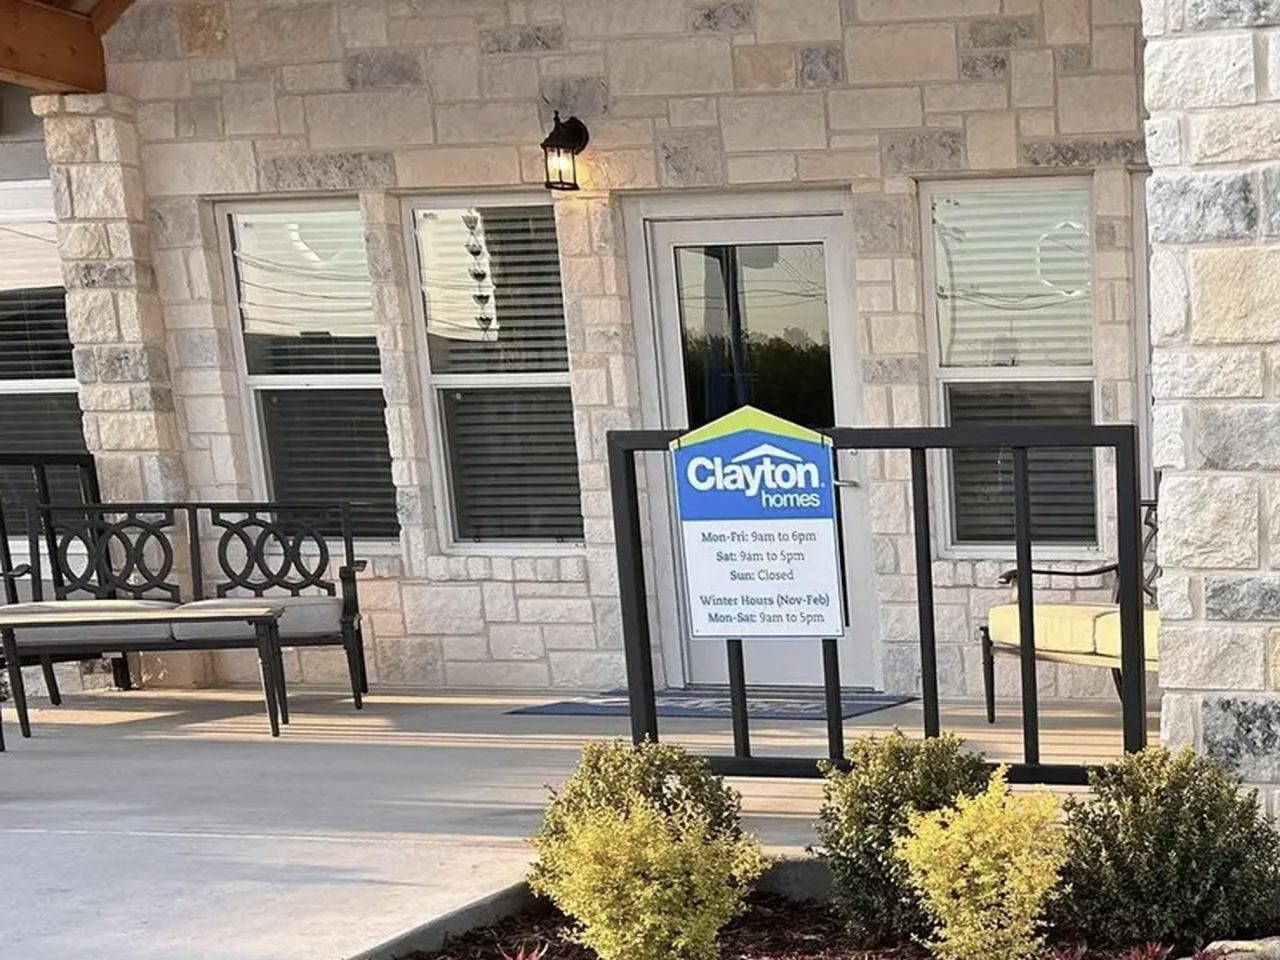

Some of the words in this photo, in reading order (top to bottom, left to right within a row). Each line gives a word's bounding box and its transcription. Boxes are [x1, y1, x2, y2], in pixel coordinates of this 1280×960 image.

[687, 456, 819, 496] Clayton
[761, 491, 821, 508] homes
[701, 531, 749, 543] Mon-Fri:
[752, 531, 775, 542] 9am
[778, 531, 790, 542] to
[792, 530, 817, 544] 6pm
[716, 551, 737, 562] Sat:
[740, 551, 764, 562] 9am
[767, 551, 778, 562] to
[781, 550, 805, 564] 5pm
[730, 570, 755, 581] Sun:
[758, 569, 794, 581] Closed
[700, 595, 739, 606] Winter
[741, 595, 774, 606] Hours
[777, 594, 830, 607] (Nov-Feb)
[708, 612, 757, 623] Mon-Sat:
[760, 612, 783, 623] 9am
[786, 612, 798, 623] to
[800, 612, 824, 625] 5pm
